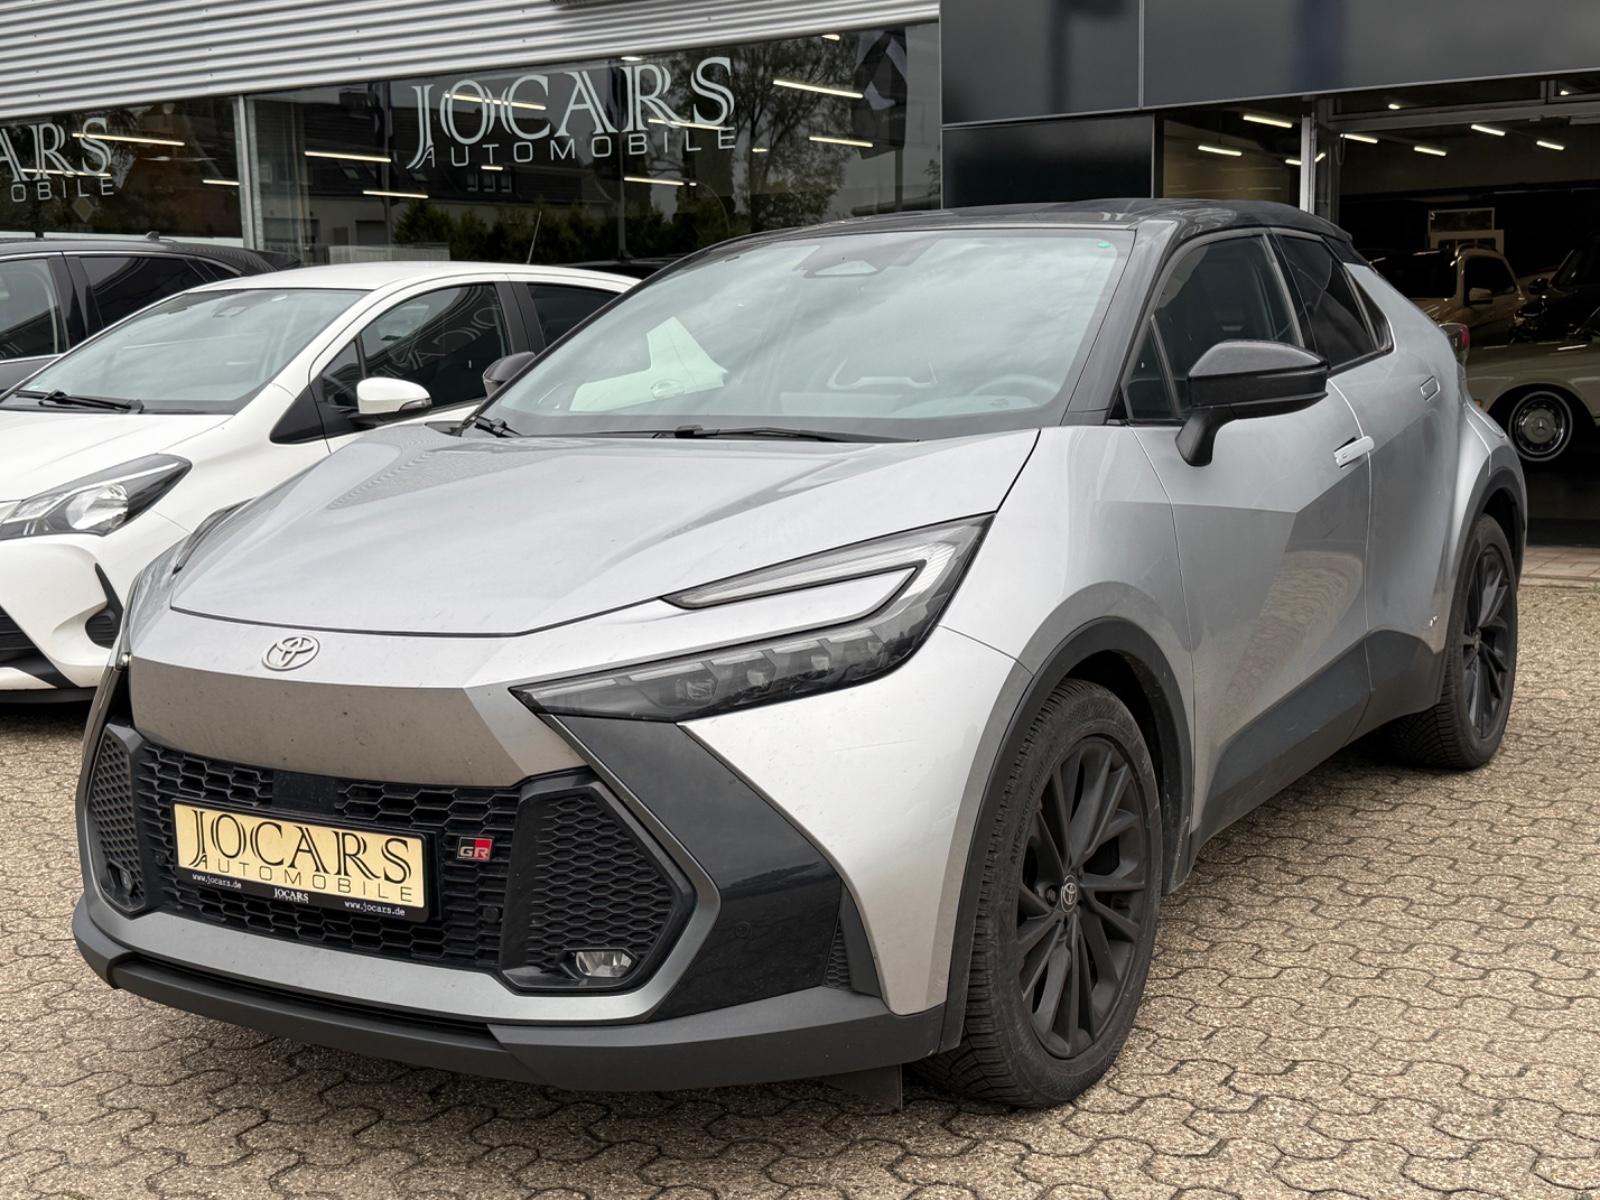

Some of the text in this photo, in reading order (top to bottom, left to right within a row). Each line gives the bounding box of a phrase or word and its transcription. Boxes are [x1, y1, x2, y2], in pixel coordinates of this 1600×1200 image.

[406, 56, 735, 169] JOCARS
[416, 126, 736, 168] AUTOMOBILE
[11, 177, 114, 202] OBILE
[189, 809, 412, 884] JOCARS
[460, 845, 490, 859] GR
[192, 872, 242, 889] www.jocars.de
[194, 854, 413, 903] AUTOMOBILE
[273, 887, 309, 902] JOCARS
[344, 900, 405, 916] www.jocars.de
